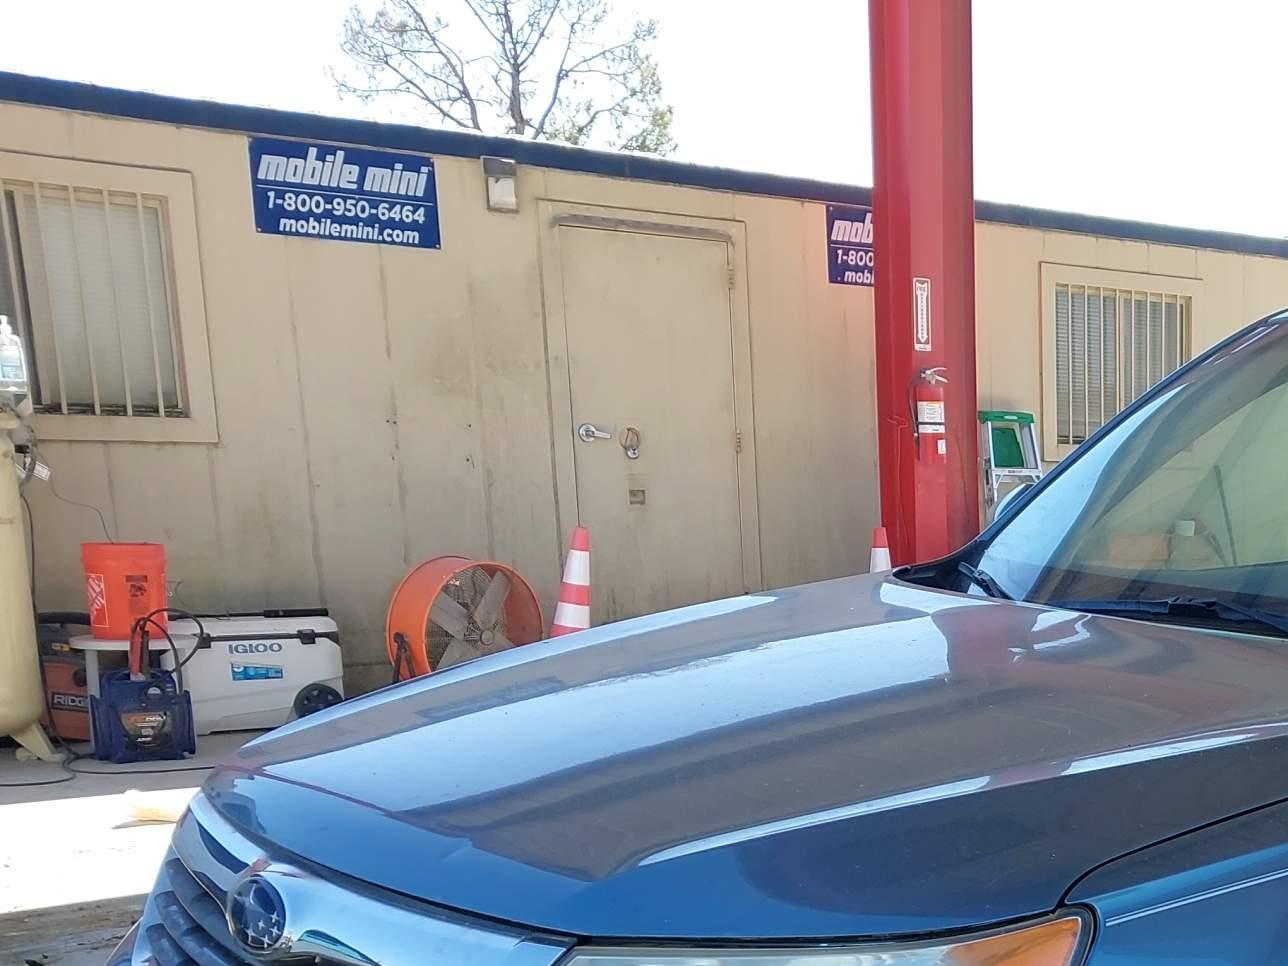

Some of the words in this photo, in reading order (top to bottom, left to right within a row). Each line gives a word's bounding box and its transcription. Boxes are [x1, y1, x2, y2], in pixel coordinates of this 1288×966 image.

[257, 147, 360, 189] mobile
[363, 163, 429, 197] mini
[266, 191, 426, 224] 1-800-950-6464
[279, 217, 420, 244] mobilemini.com
[228, 642, 283, 655] IGLOO
